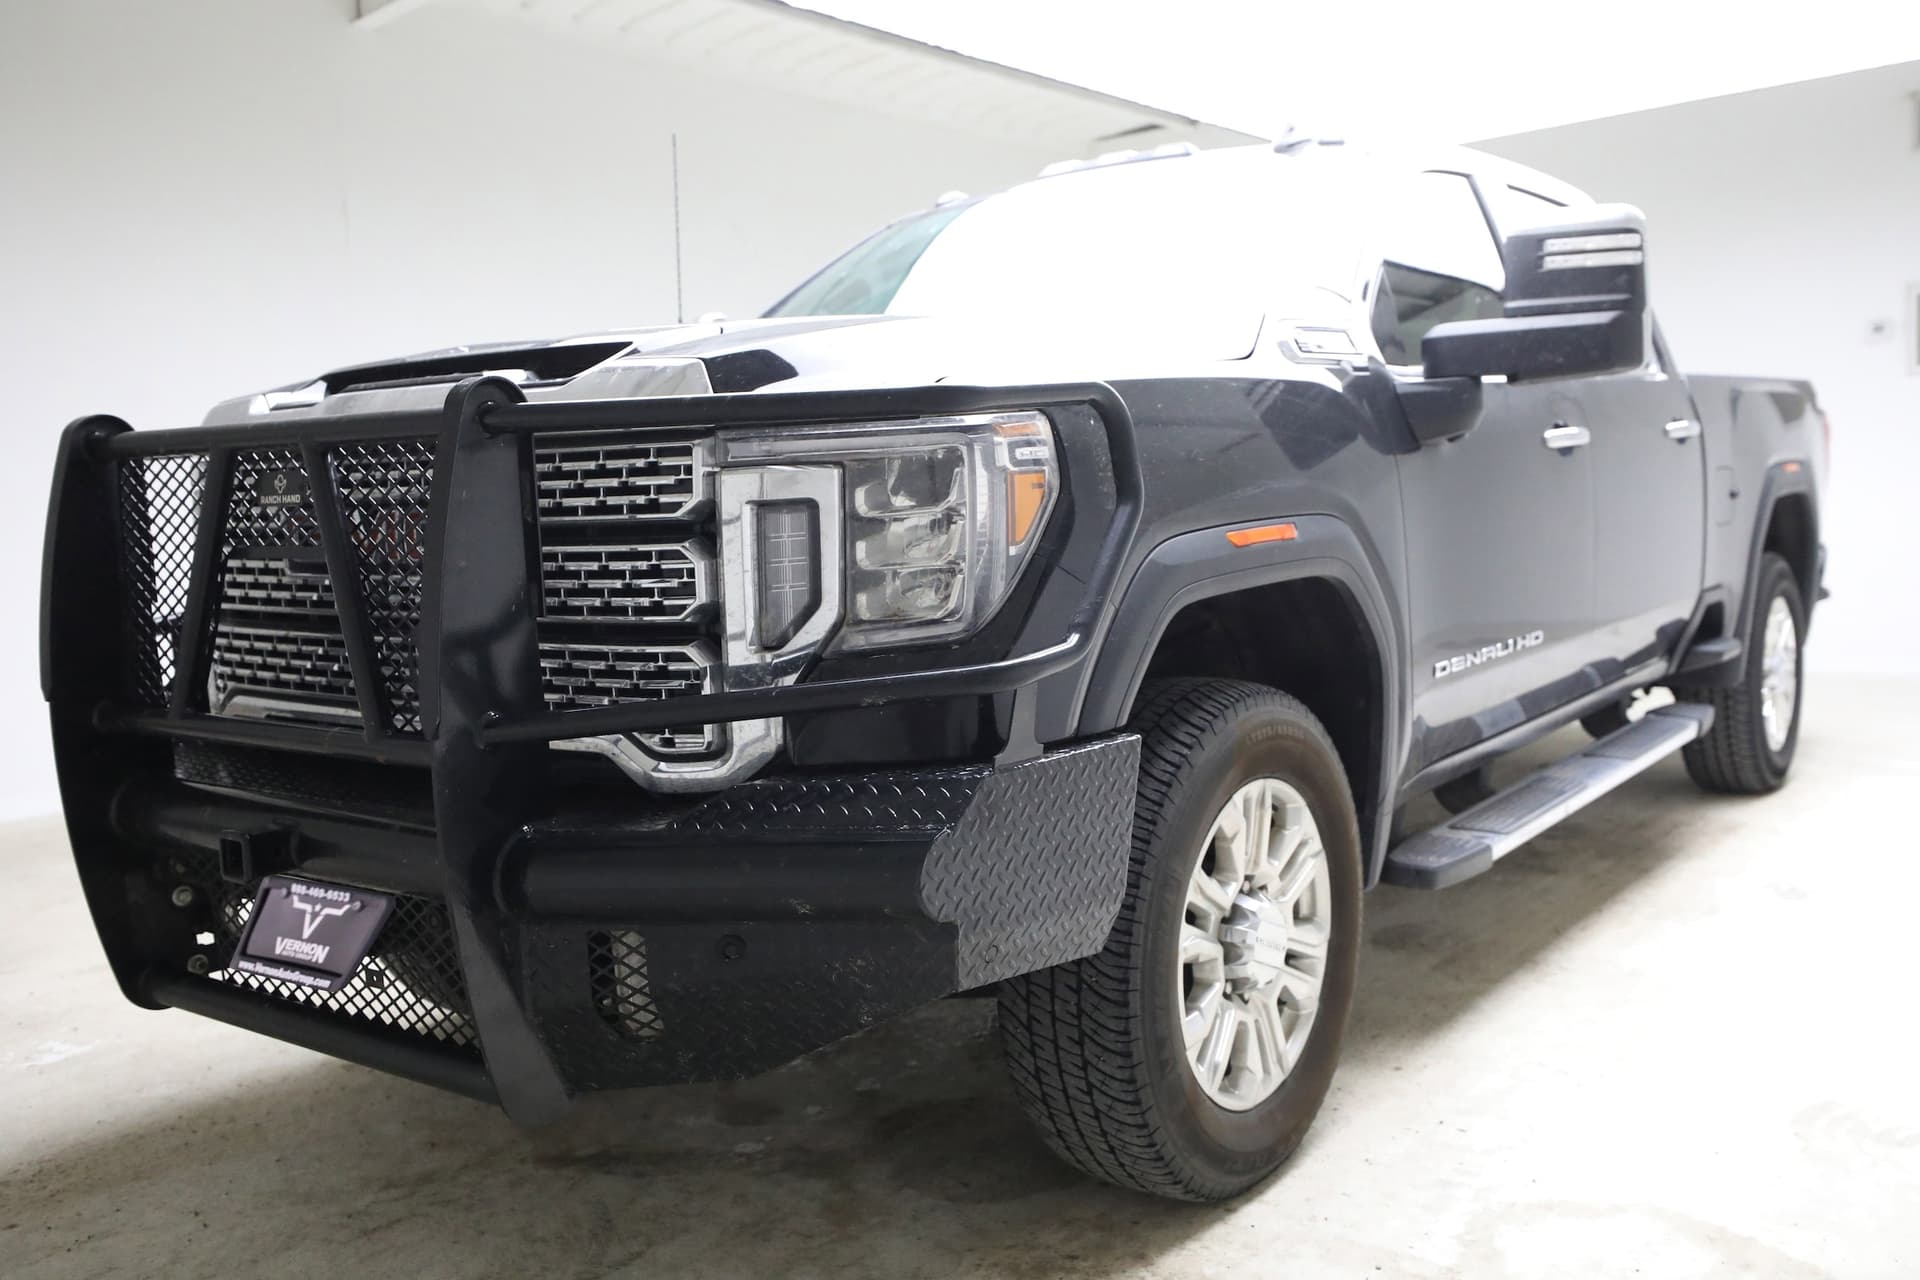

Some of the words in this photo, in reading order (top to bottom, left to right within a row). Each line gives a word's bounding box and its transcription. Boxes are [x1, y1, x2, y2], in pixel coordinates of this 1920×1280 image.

[261, 495, 281, 504] RANCH
[282, 494, 301, 504] HAND
[1432, 638, 1514, 679] DENALI
[1516, 630, 1544, 651] HD
[275, 937, 329, 963] VERNON
